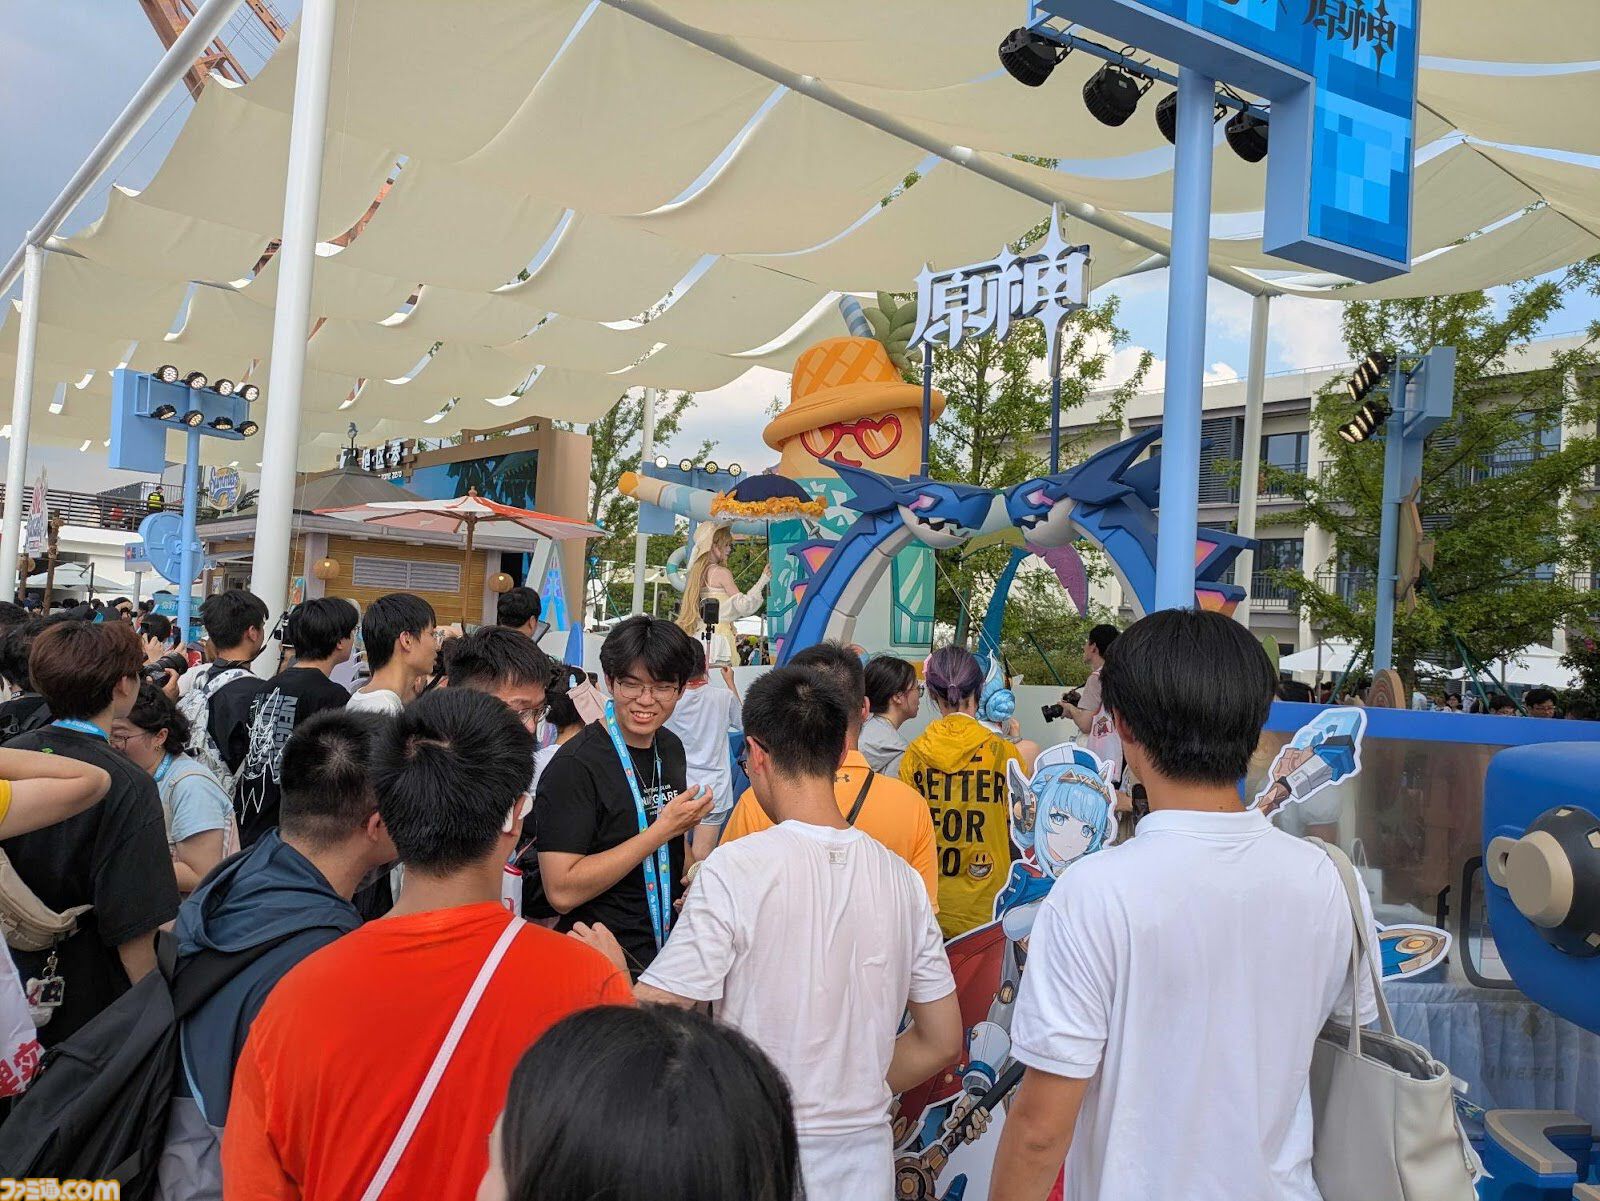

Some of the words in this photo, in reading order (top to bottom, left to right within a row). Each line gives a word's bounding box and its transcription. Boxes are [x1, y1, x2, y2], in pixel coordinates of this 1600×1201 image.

[1303, 0, 1397, 88] 原神
[905, 202, 1088, 377] 原神
[913, 767, 1006, 804] BETTER
[930, 807, 986, 843] FOR
